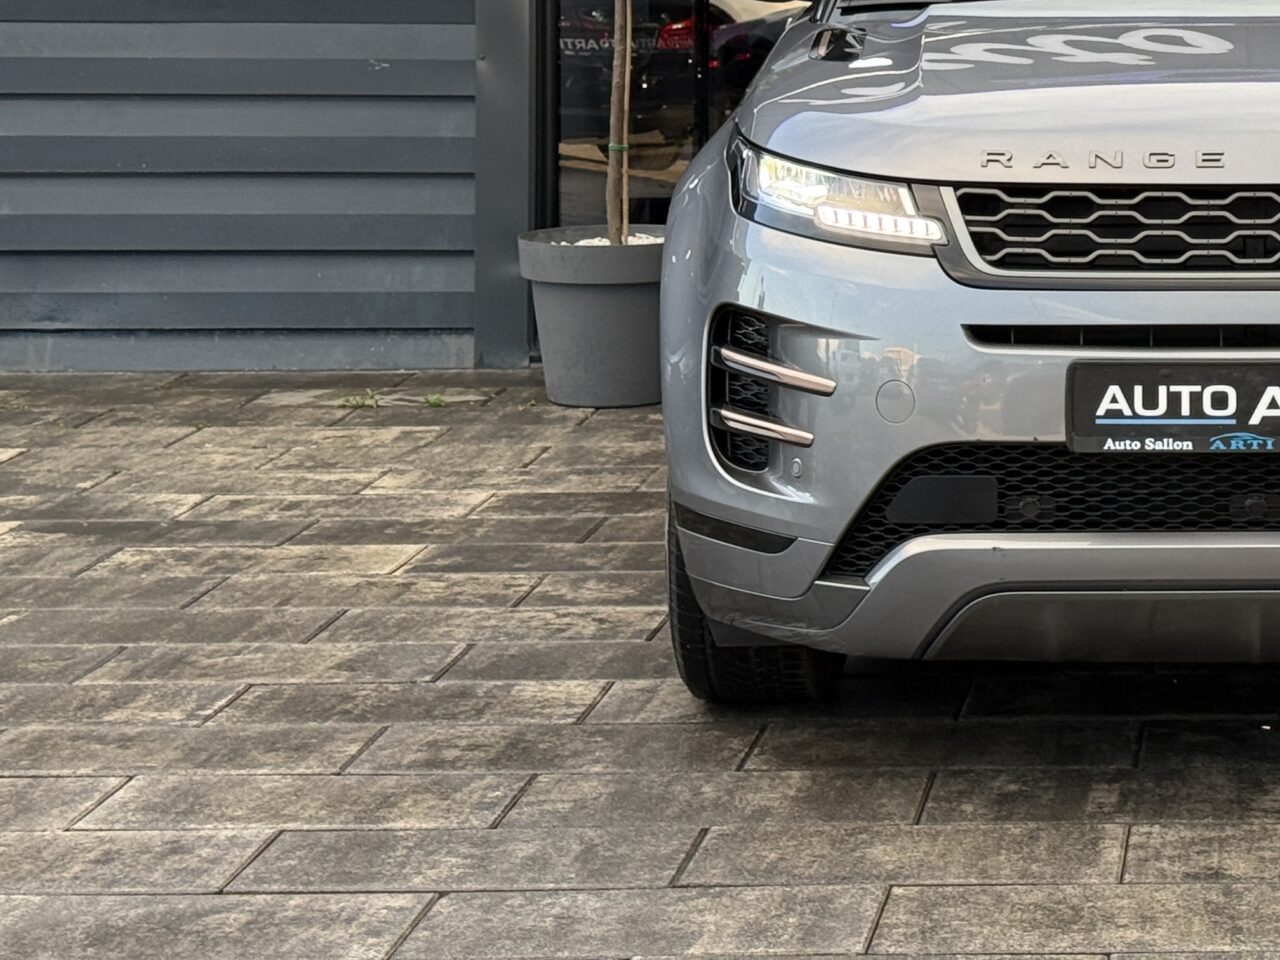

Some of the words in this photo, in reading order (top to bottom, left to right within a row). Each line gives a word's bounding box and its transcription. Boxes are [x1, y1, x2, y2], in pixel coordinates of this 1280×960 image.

[980, 150, 1226, 169] RANGE
[1095, 384, 1237, 417] AUTO
[1103, 437, 1142, 451] Auto
[1209, 439, 1275, 450] ARTI
